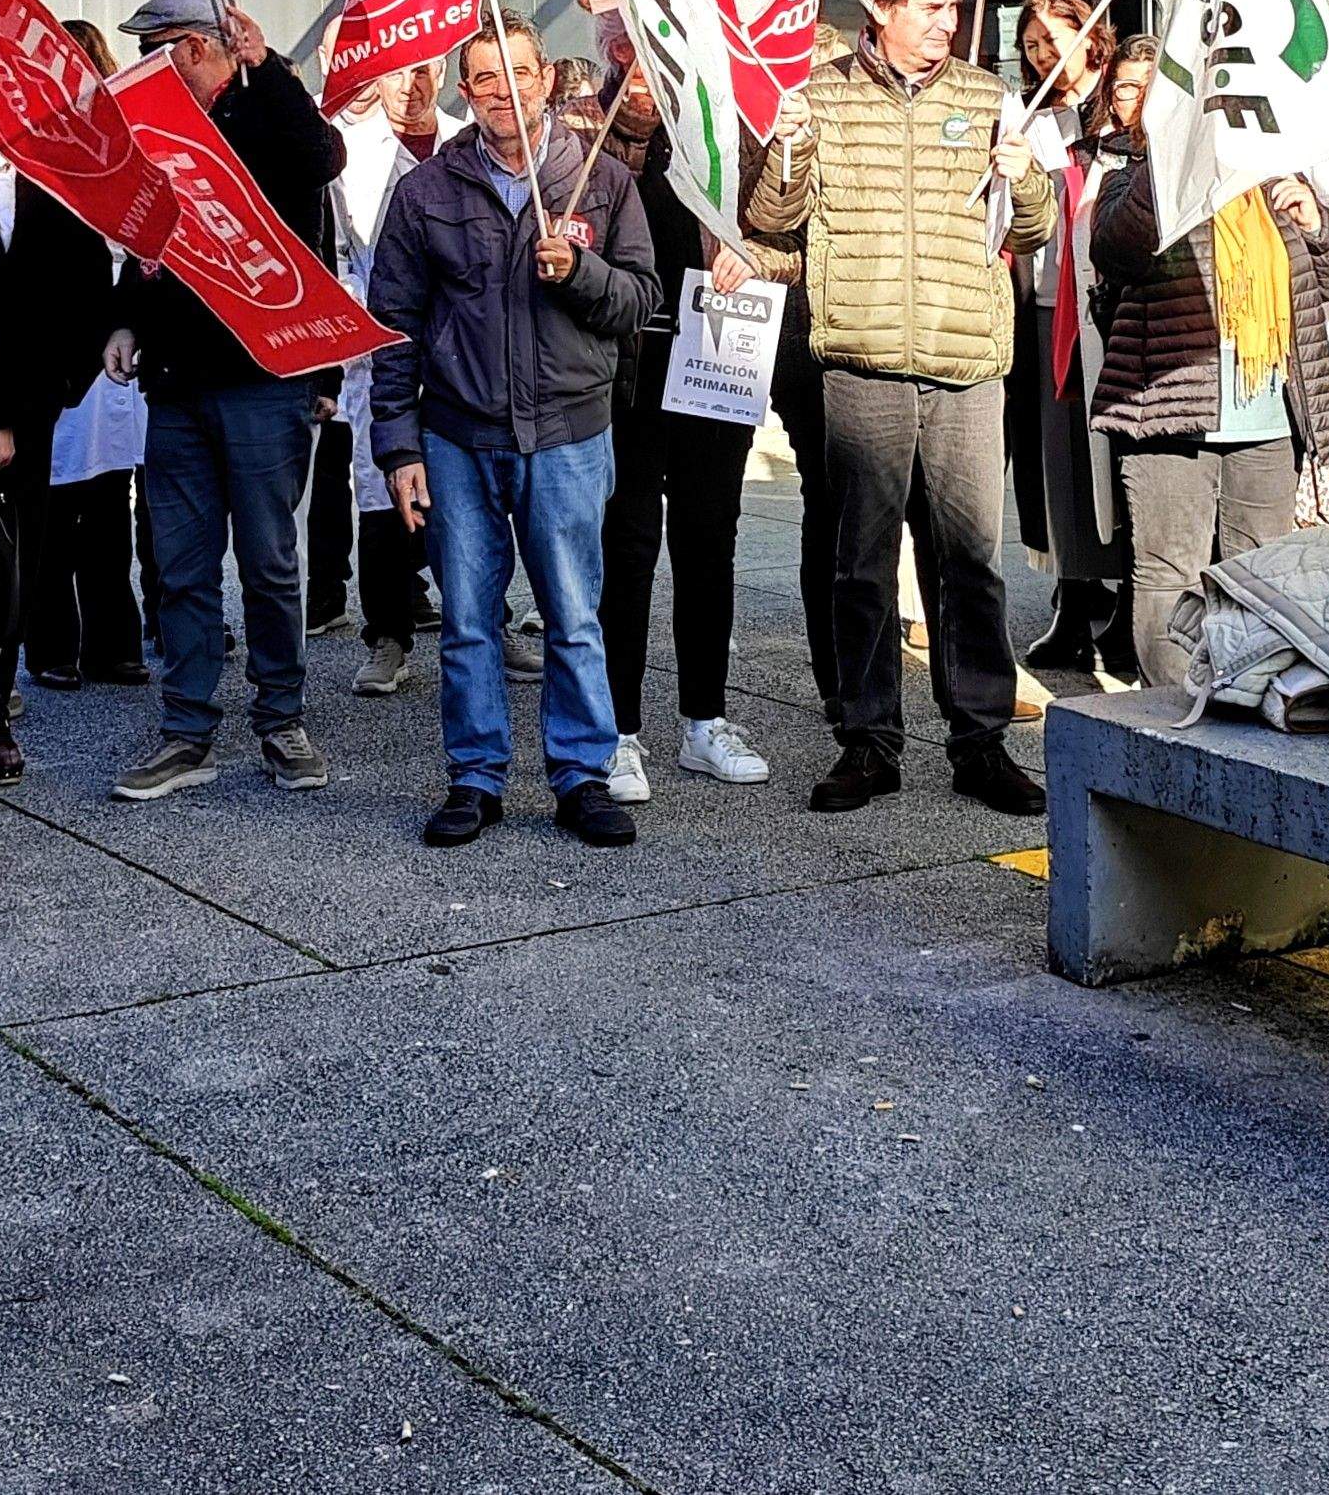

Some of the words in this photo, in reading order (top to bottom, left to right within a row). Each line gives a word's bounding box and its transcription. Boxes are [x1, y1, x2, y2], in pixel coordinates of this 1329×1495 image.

[330, 0, 473, 74] ww.UGT.es
[700, 293, 768, 319] FOLGA
[684, 357, 759, 380] ATENCIÓN
[683, 375, 754, 399] PRIMARIA
